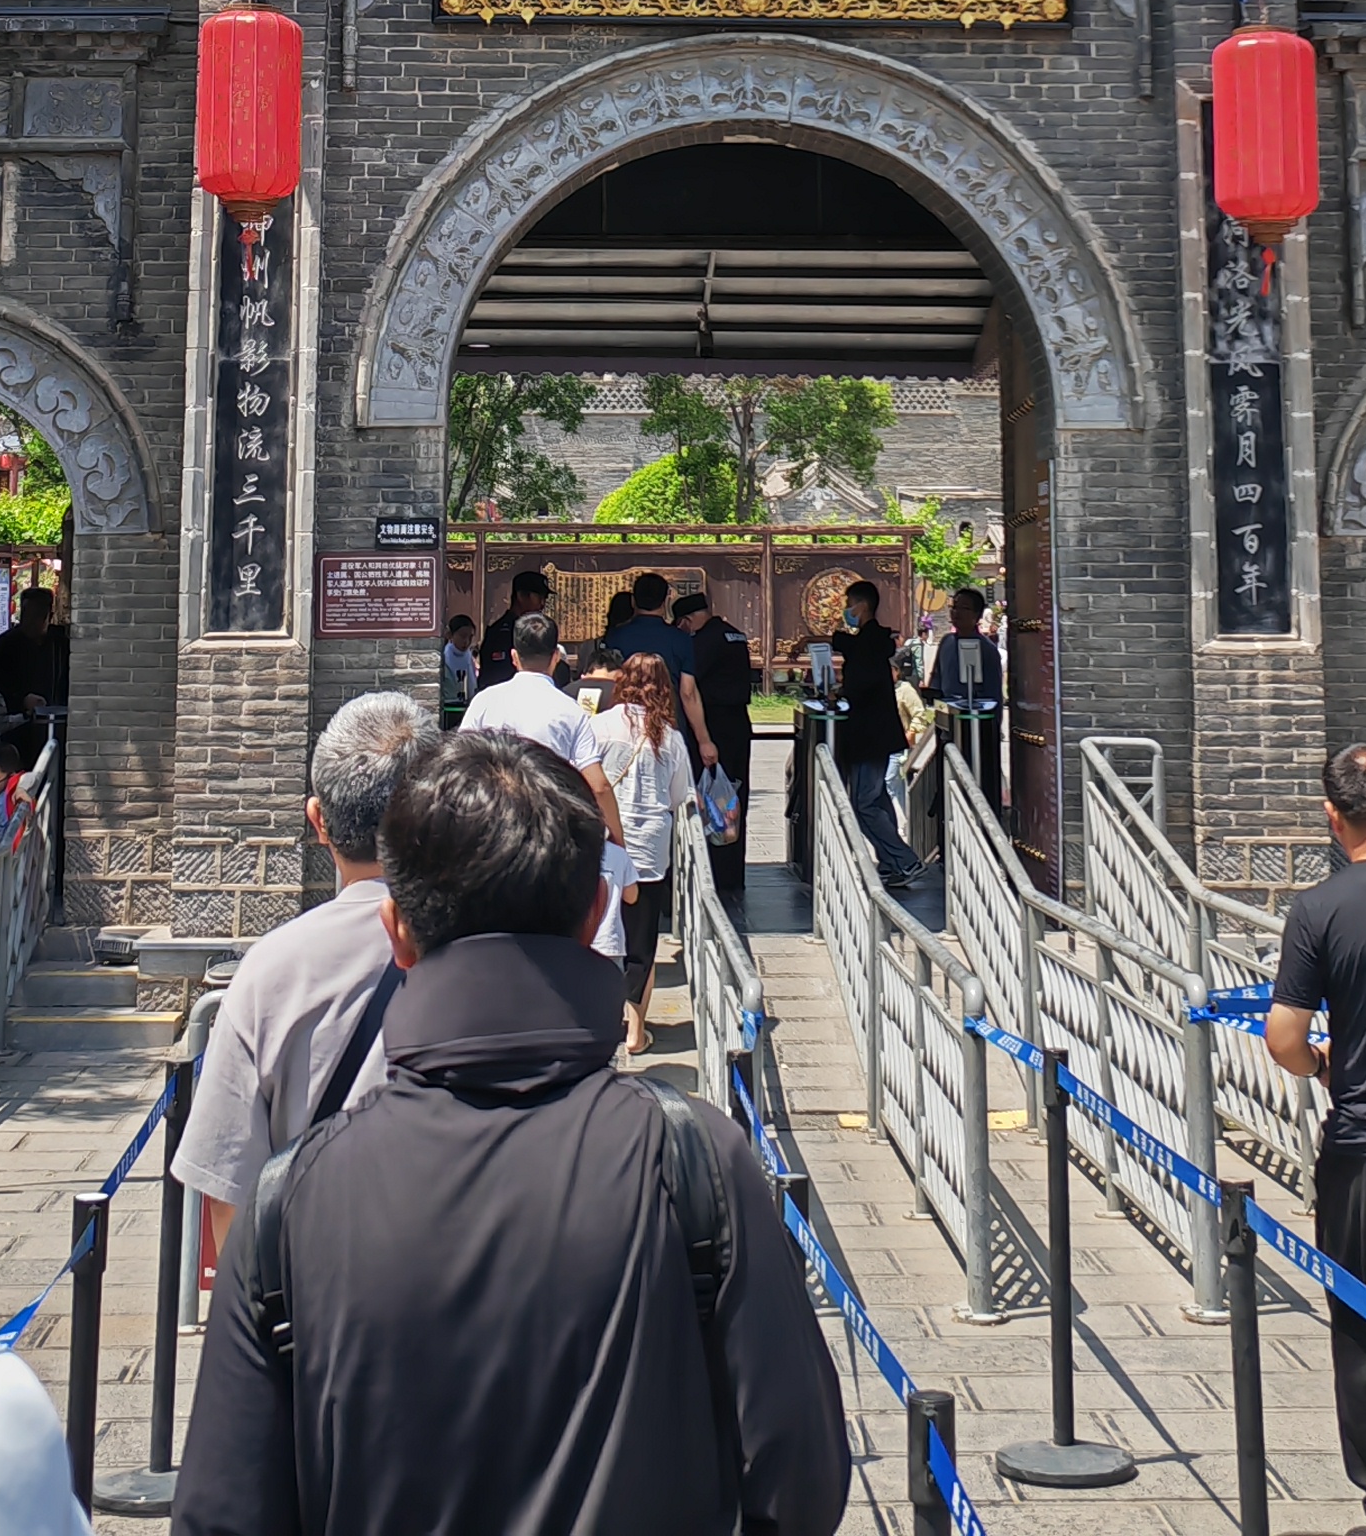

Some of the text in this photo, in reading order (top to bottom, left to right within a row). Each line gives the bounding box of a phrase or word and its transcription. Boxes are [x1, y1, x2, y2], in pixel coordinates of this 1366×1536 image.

[1276, 1228, 1335, 1289] 康百万庄园
